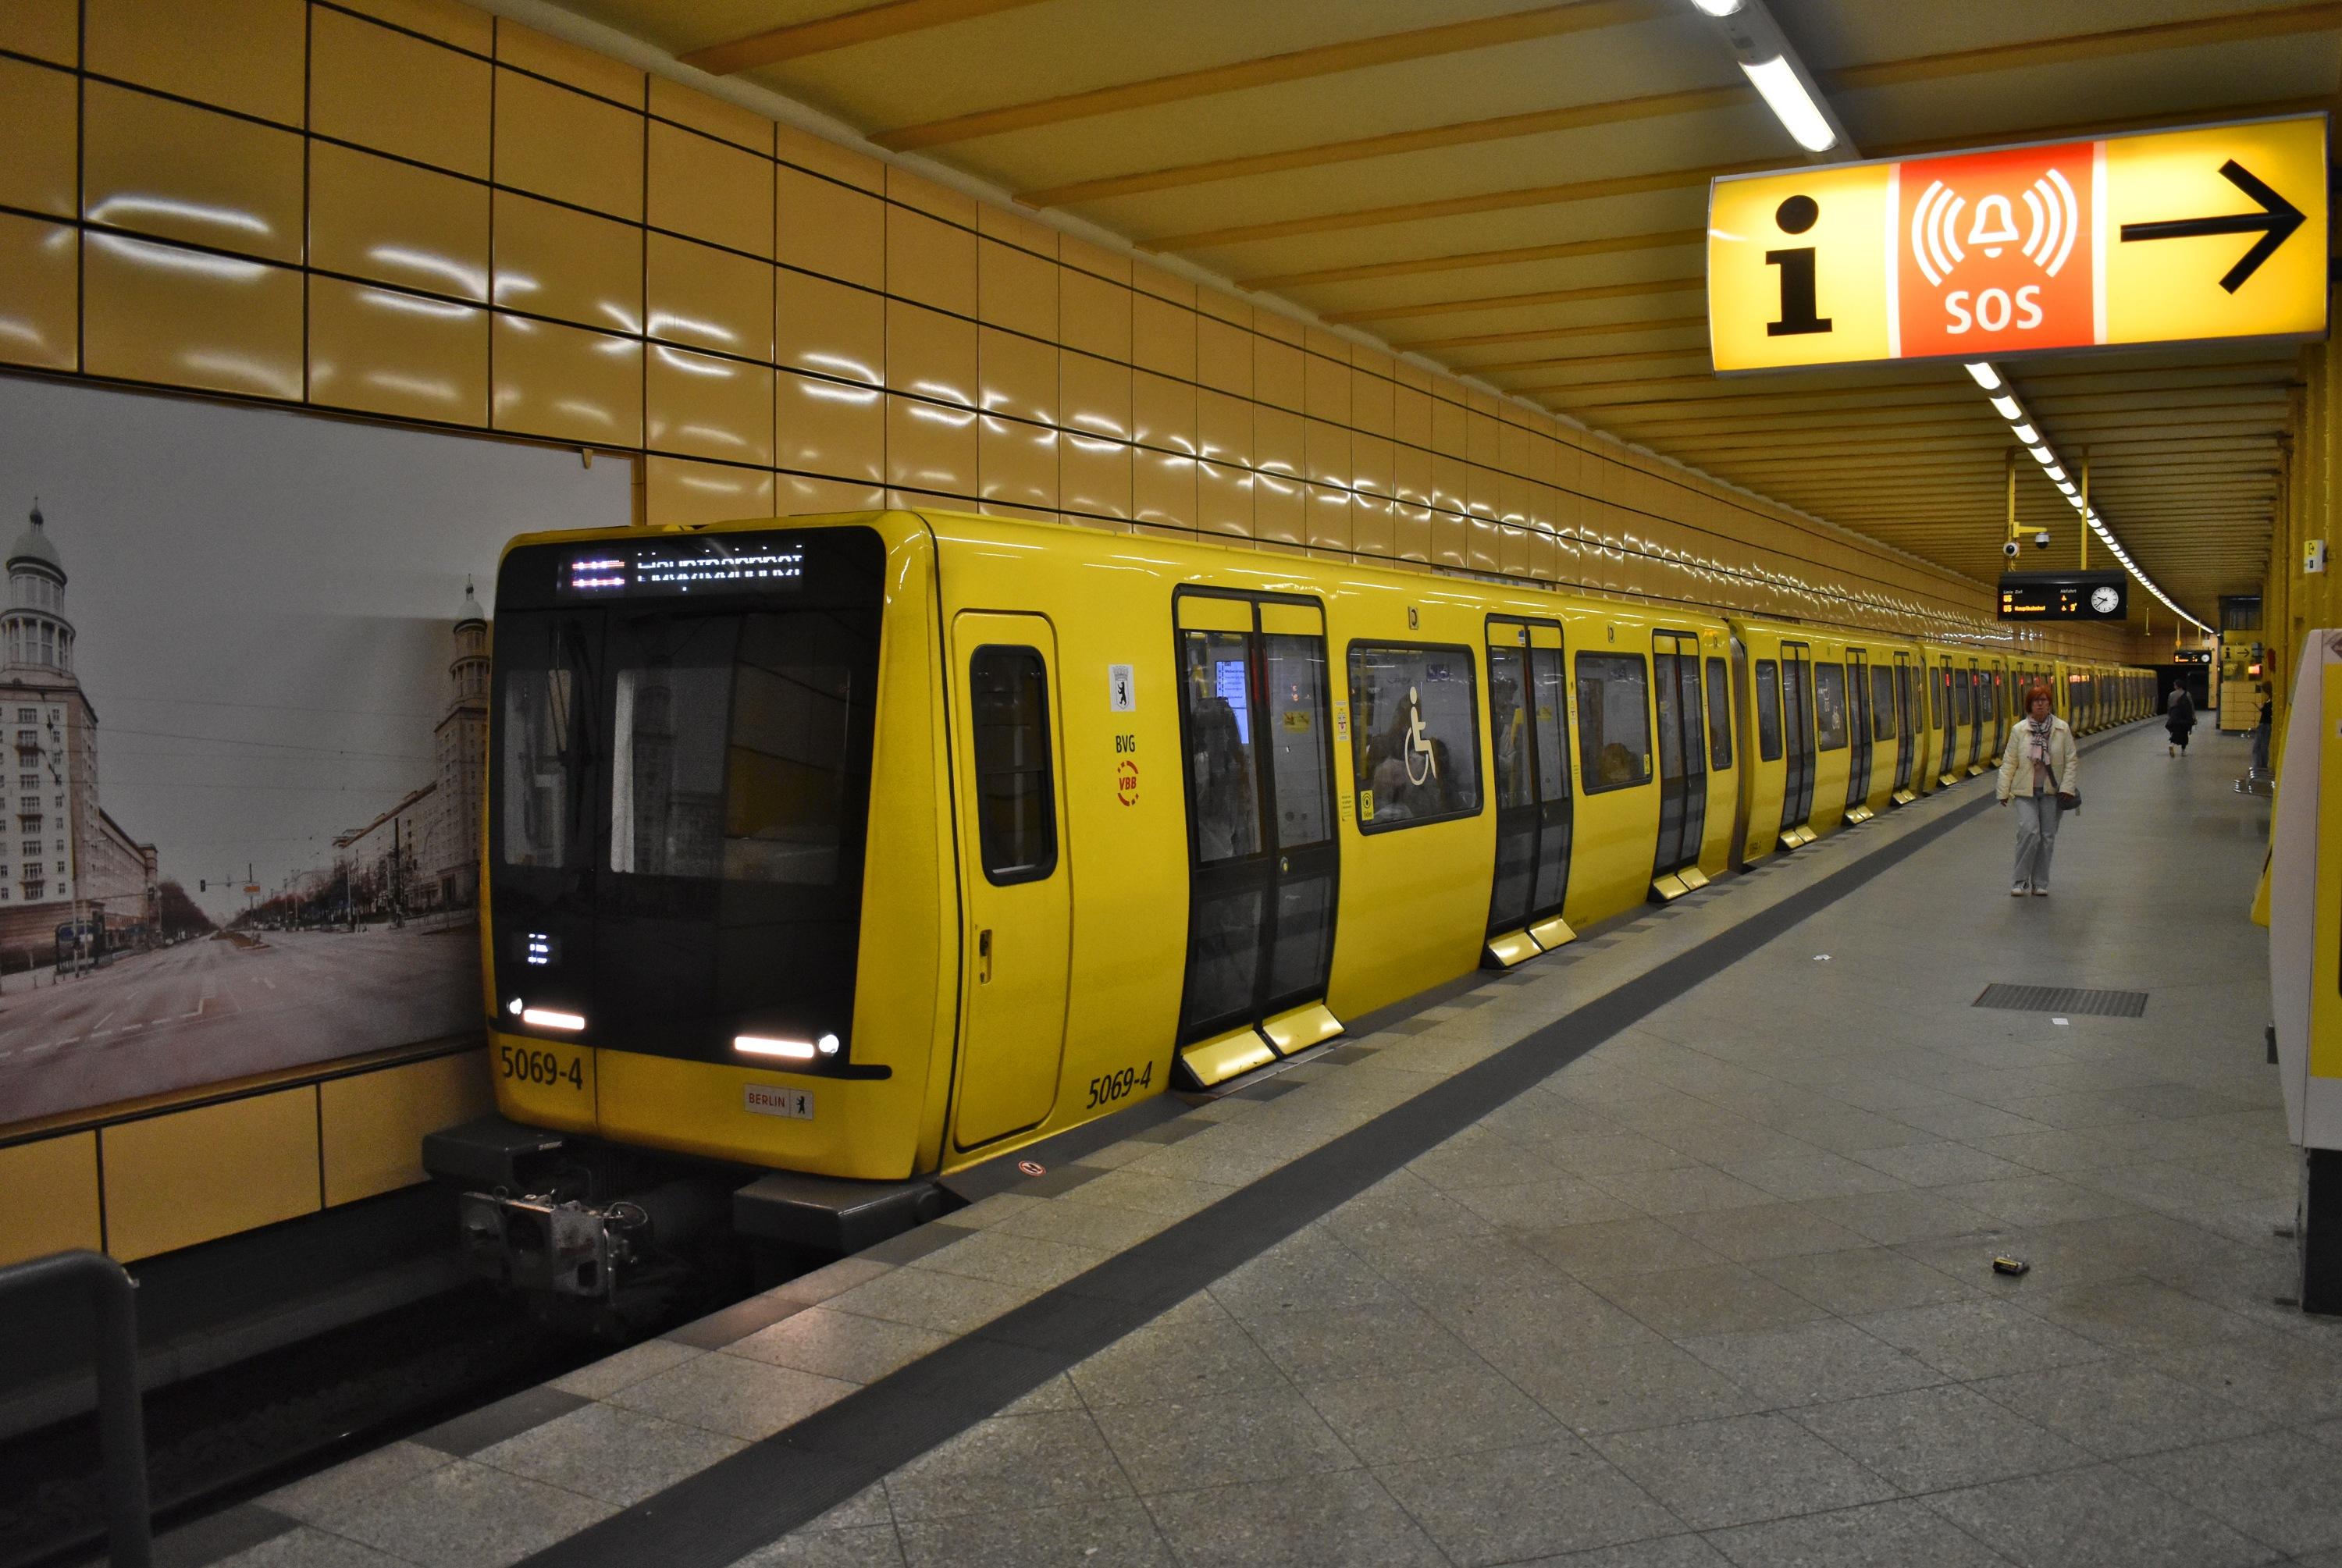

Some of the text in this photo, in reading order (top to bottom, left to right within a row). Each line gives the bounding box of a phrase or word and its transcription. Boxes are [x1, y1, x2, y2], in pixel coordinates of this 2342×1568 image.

[1944, 284, 2044, 335] SOS
[1115, 734, 1136, 754] BVG
[1118, 776, 1137, 791] VBB
[500, 1046, 583, 1090] 5069-4
[748, 1093, 786, 1109] BERLIN
[1086, 1060, 1153, 1110] 5069-4
